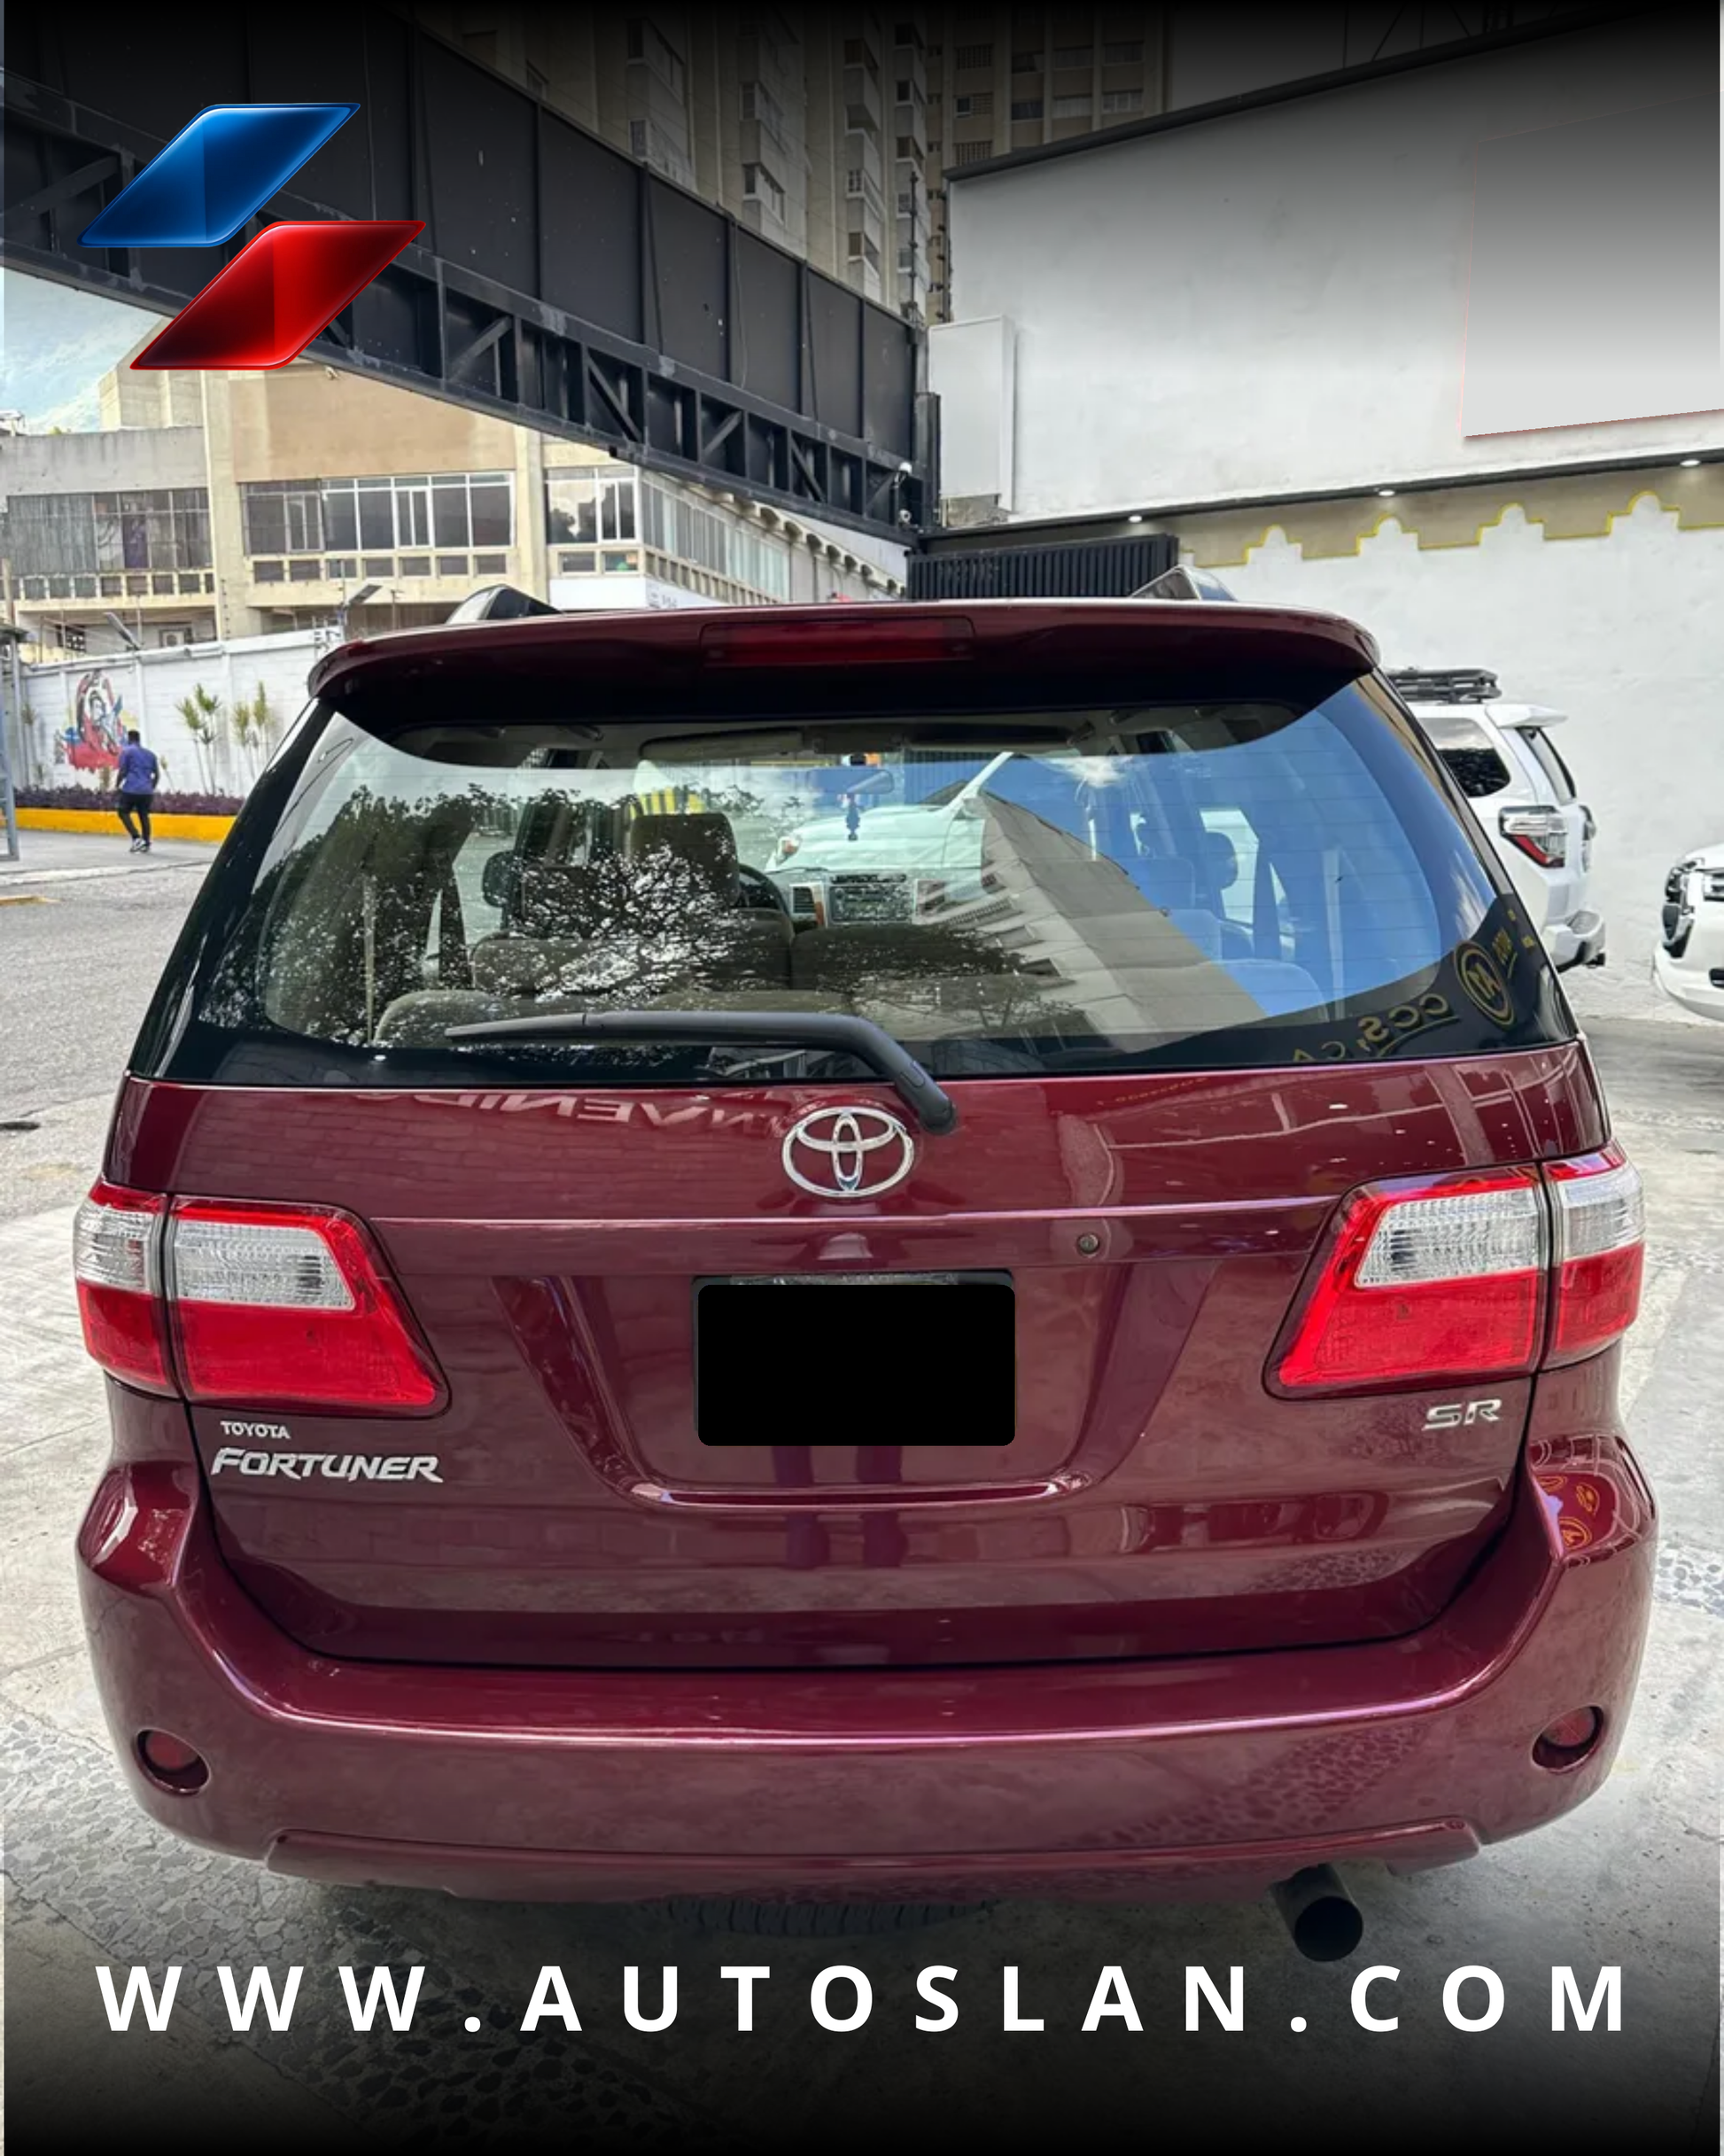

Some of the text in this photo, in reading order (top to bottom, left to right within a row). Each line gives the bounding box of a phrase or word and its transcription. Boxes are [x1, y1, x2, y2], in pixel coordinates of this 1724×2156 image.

[220, 1420, 291, 1439] TOYOTA
[1421, 1398, 1503, 1432] SR
[210, 1446, 444, 1483] FORTUNER
